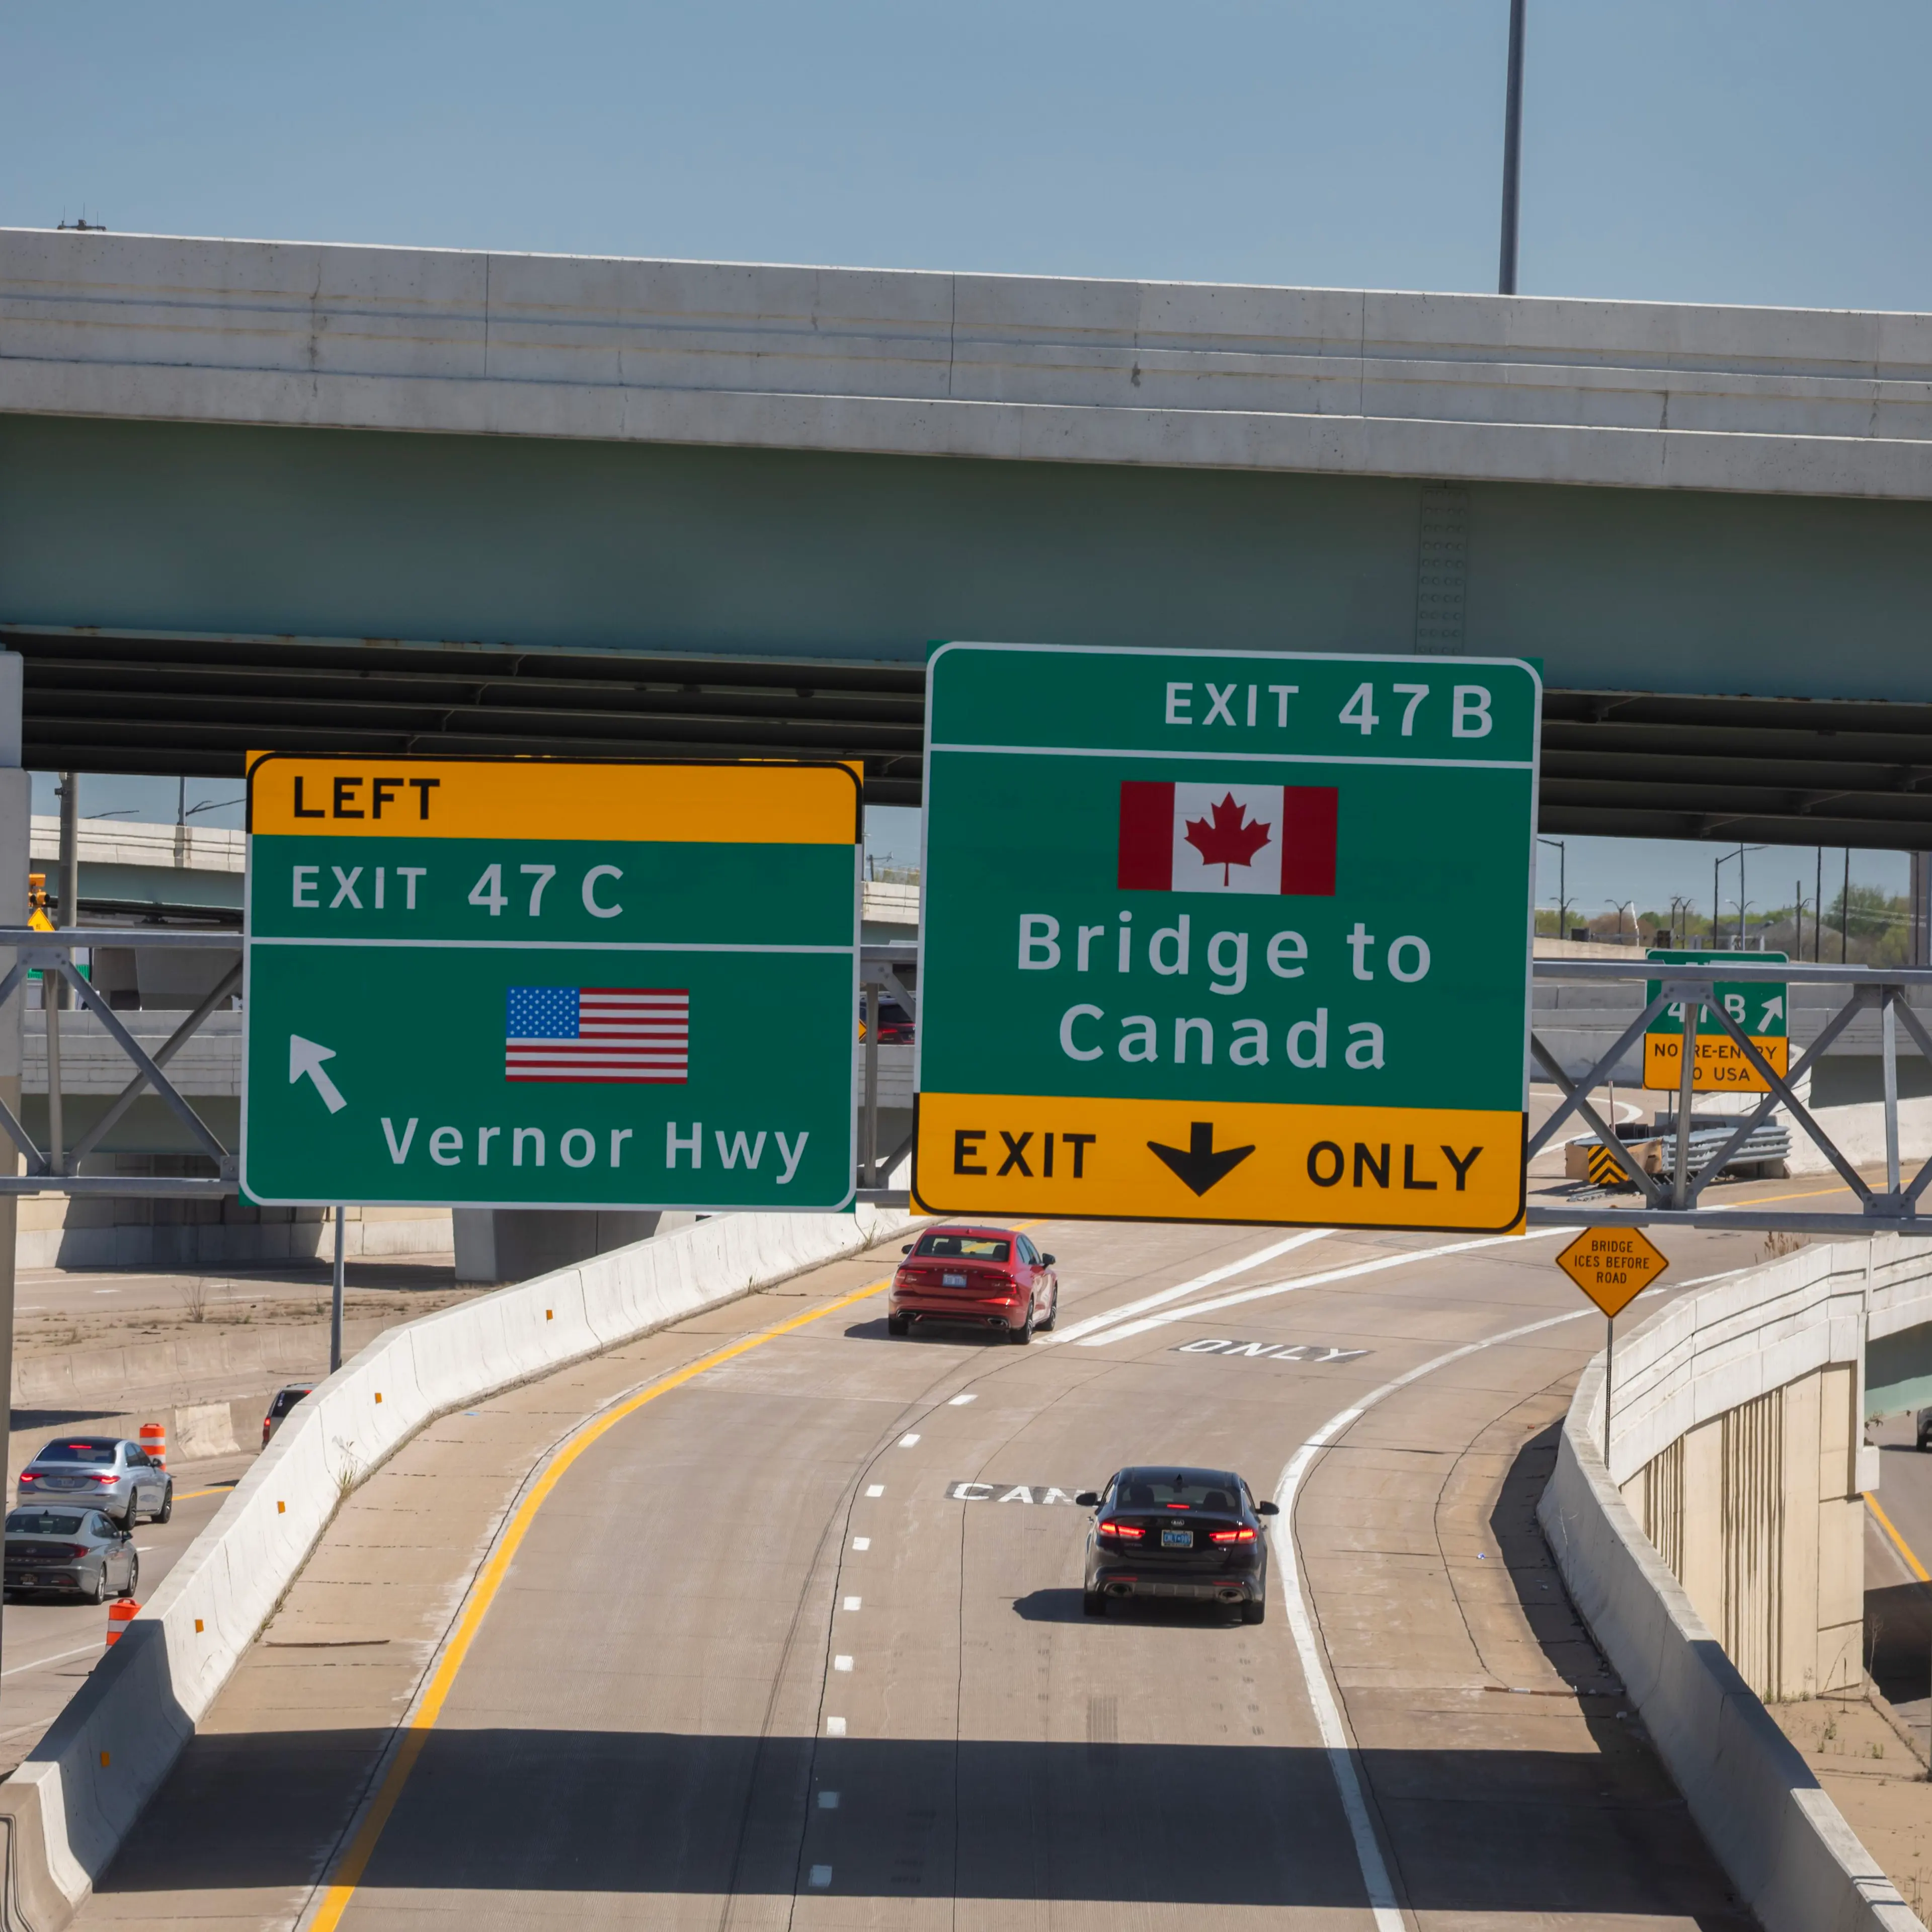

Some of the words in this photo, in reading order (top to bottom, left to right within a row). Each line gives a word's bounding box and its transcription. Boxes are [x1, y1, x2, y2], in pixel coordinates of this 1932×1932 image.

[1165, 682, 1299, 728] EXIT
[1338, 682, 1430, 736] 47
[1452, 685, 1493, 738] B
[294, 775, 441, 821] LEFT
[292, 865, 427, 910] EXIT
[467, 863, 556, 917] 47
[582, 864, 624, 919] C
[1017, 910, 1309, 996] Bridge
[1346, 923, 1431, 984] to
[1059, 1003, 1386, 1070] Canada
[1654, 1043, 1678, 1057] NO
[1714, 1067, 1750, 1082] USA
[380, 1116, 633, 1169] Vernor
[666, 1121, 810, 1184] Hwy
[953, 1129, 1097, 1179] EXIT
[1307, 1140, 1484, 1191] ONLY
[1574, 1255, 1600, 1267] ICES
[1606, 1256, 1650, 1269] BEFORE
[1591, 1240, 1633, 1253] BRIDGE
[1596, 1271, 1627, 1284] ROAD
[1179, 1339, 1368, 1362] ONLY
